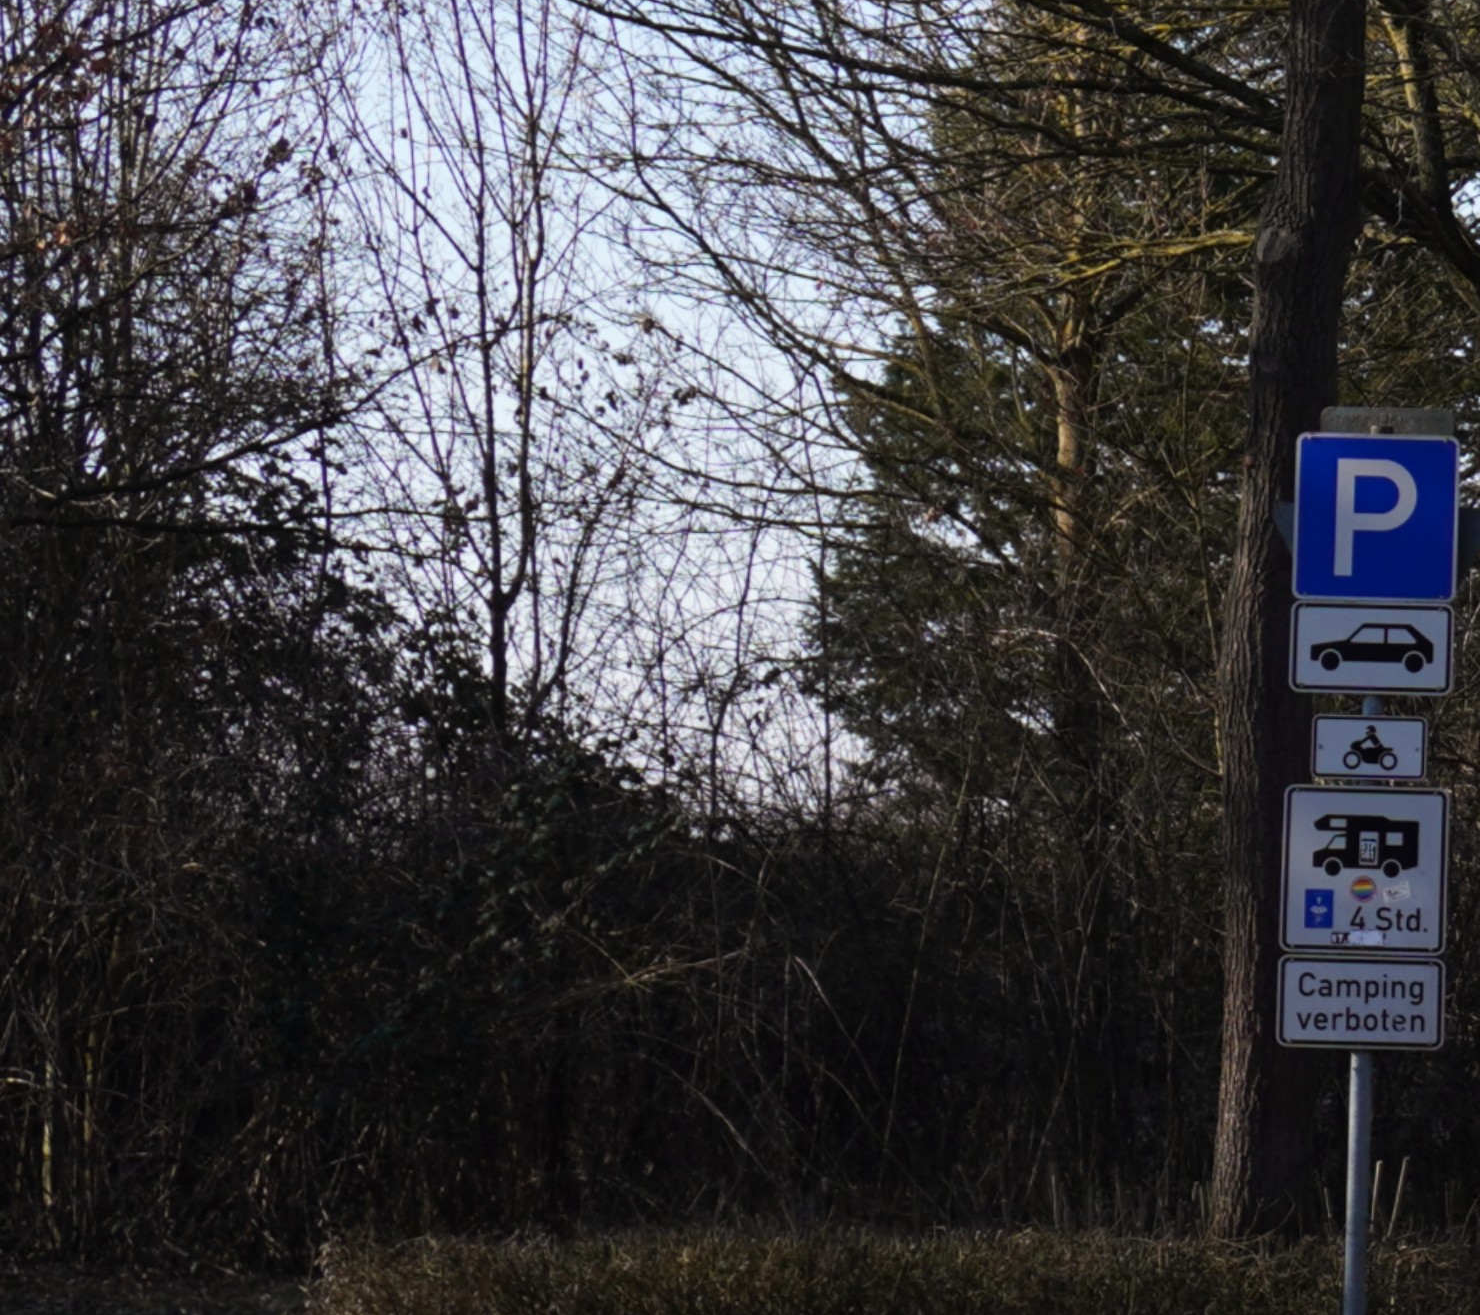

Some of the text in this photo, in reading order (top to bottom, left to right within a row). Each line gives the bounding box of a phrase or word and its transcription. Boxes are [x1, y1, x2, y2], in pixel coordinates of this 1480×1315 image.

[1333, 458, 1418, 577] P
[1350, 906, 1428, 933] 4 Std.
[1298, 972, 1425, 1005] Camping
[1297, 1006, 1425, 1032] verboten
